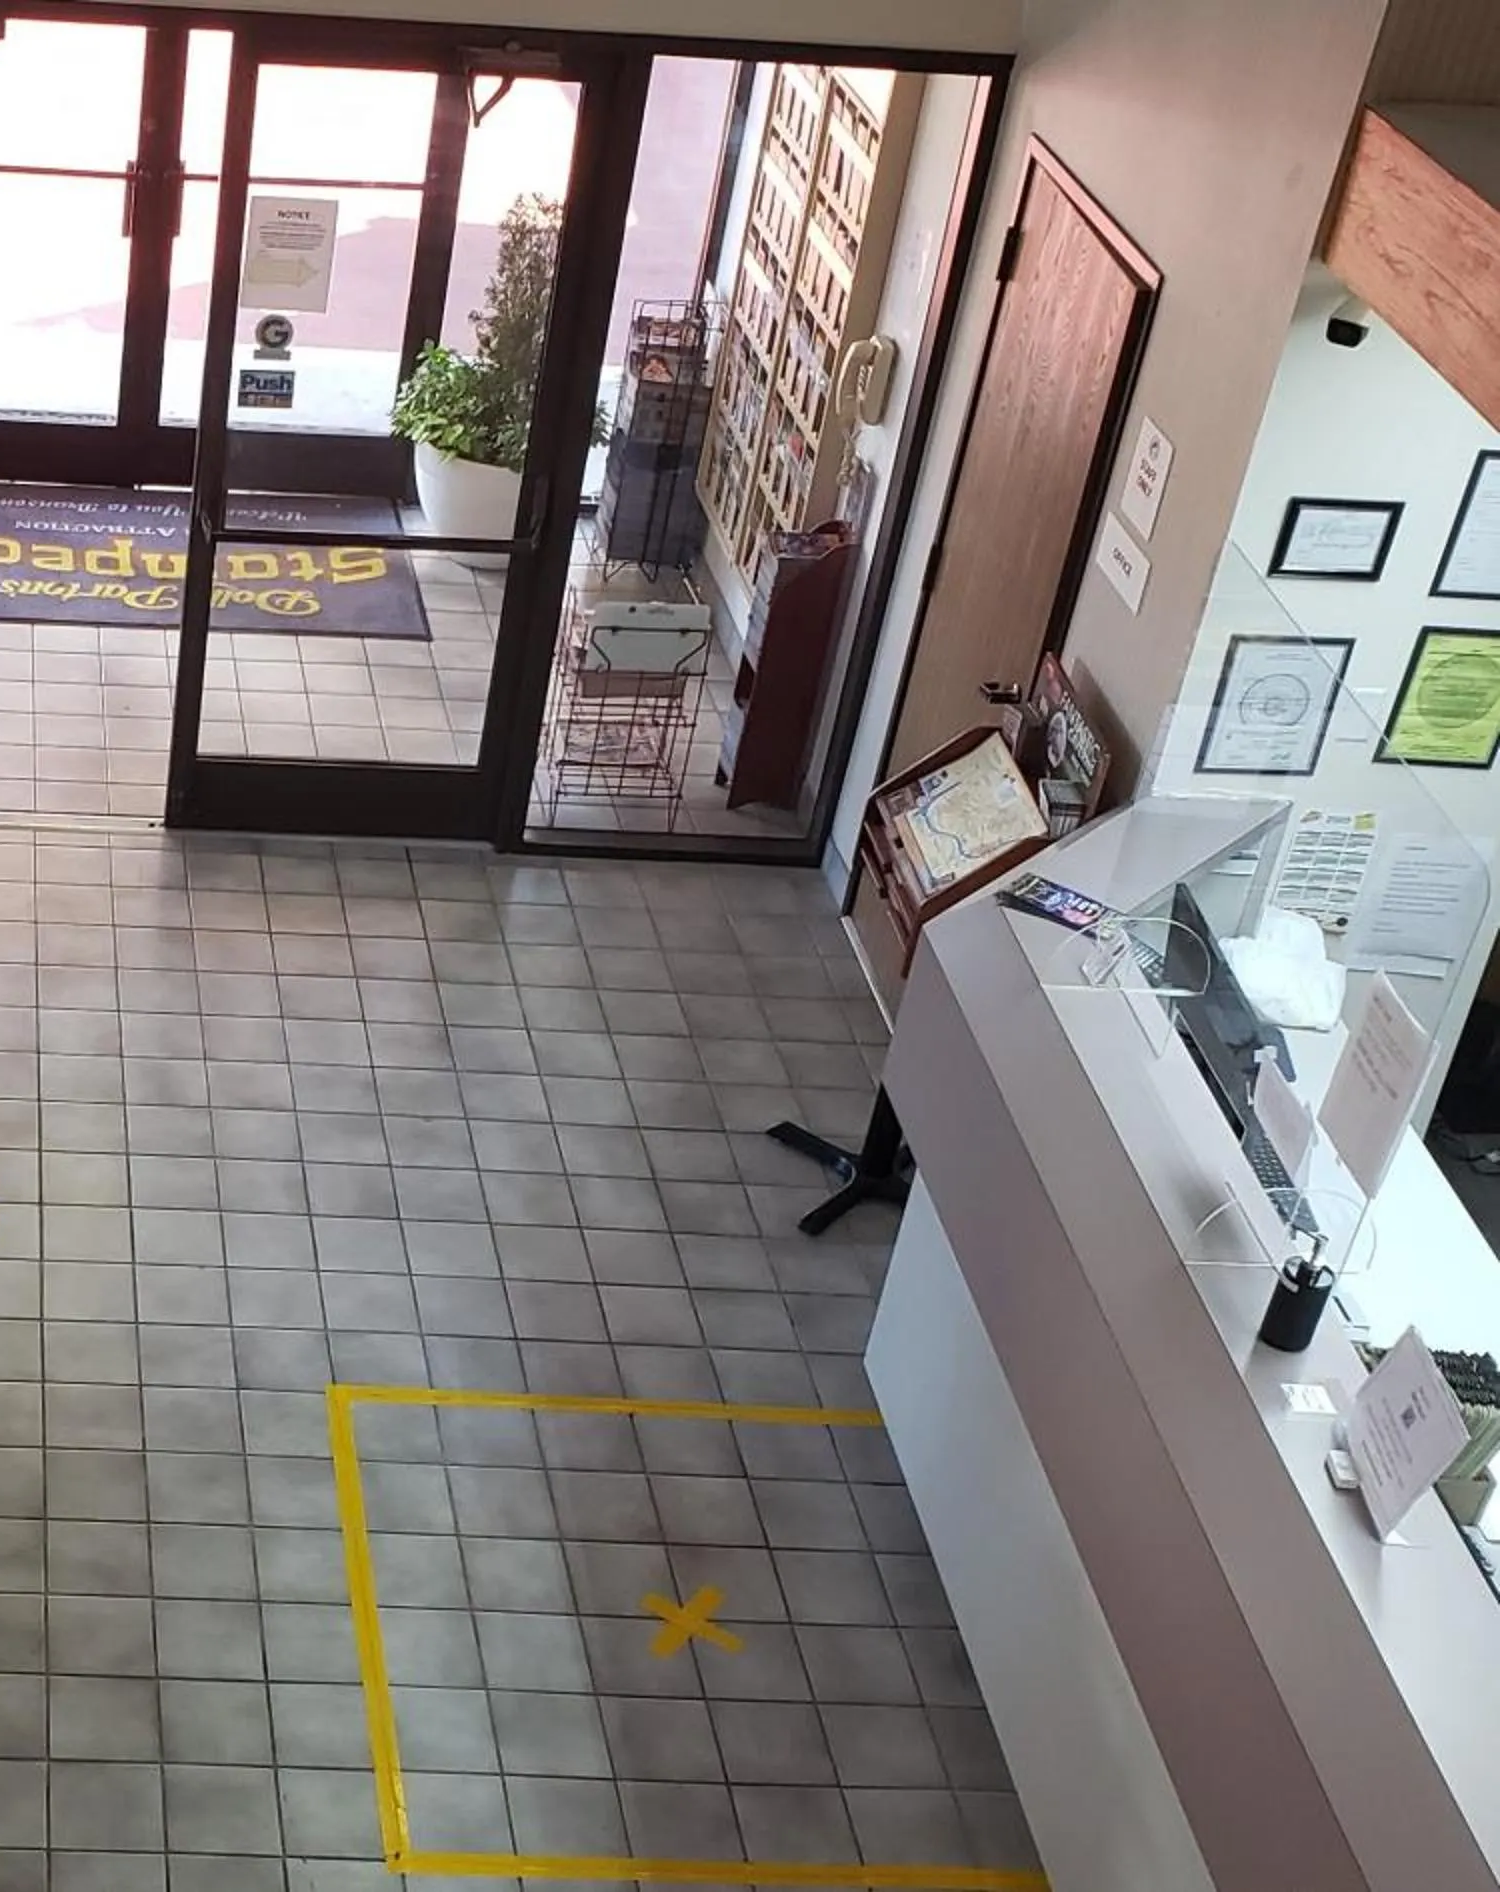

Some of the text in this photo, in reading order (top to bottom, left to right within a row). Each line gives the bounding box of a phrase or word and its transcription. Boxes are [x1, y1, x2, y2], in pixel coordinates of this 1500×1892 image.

[241, 373, 292, 391] Push
[106, 503, 129, 517] to
[138, 504, 185, 519] You
